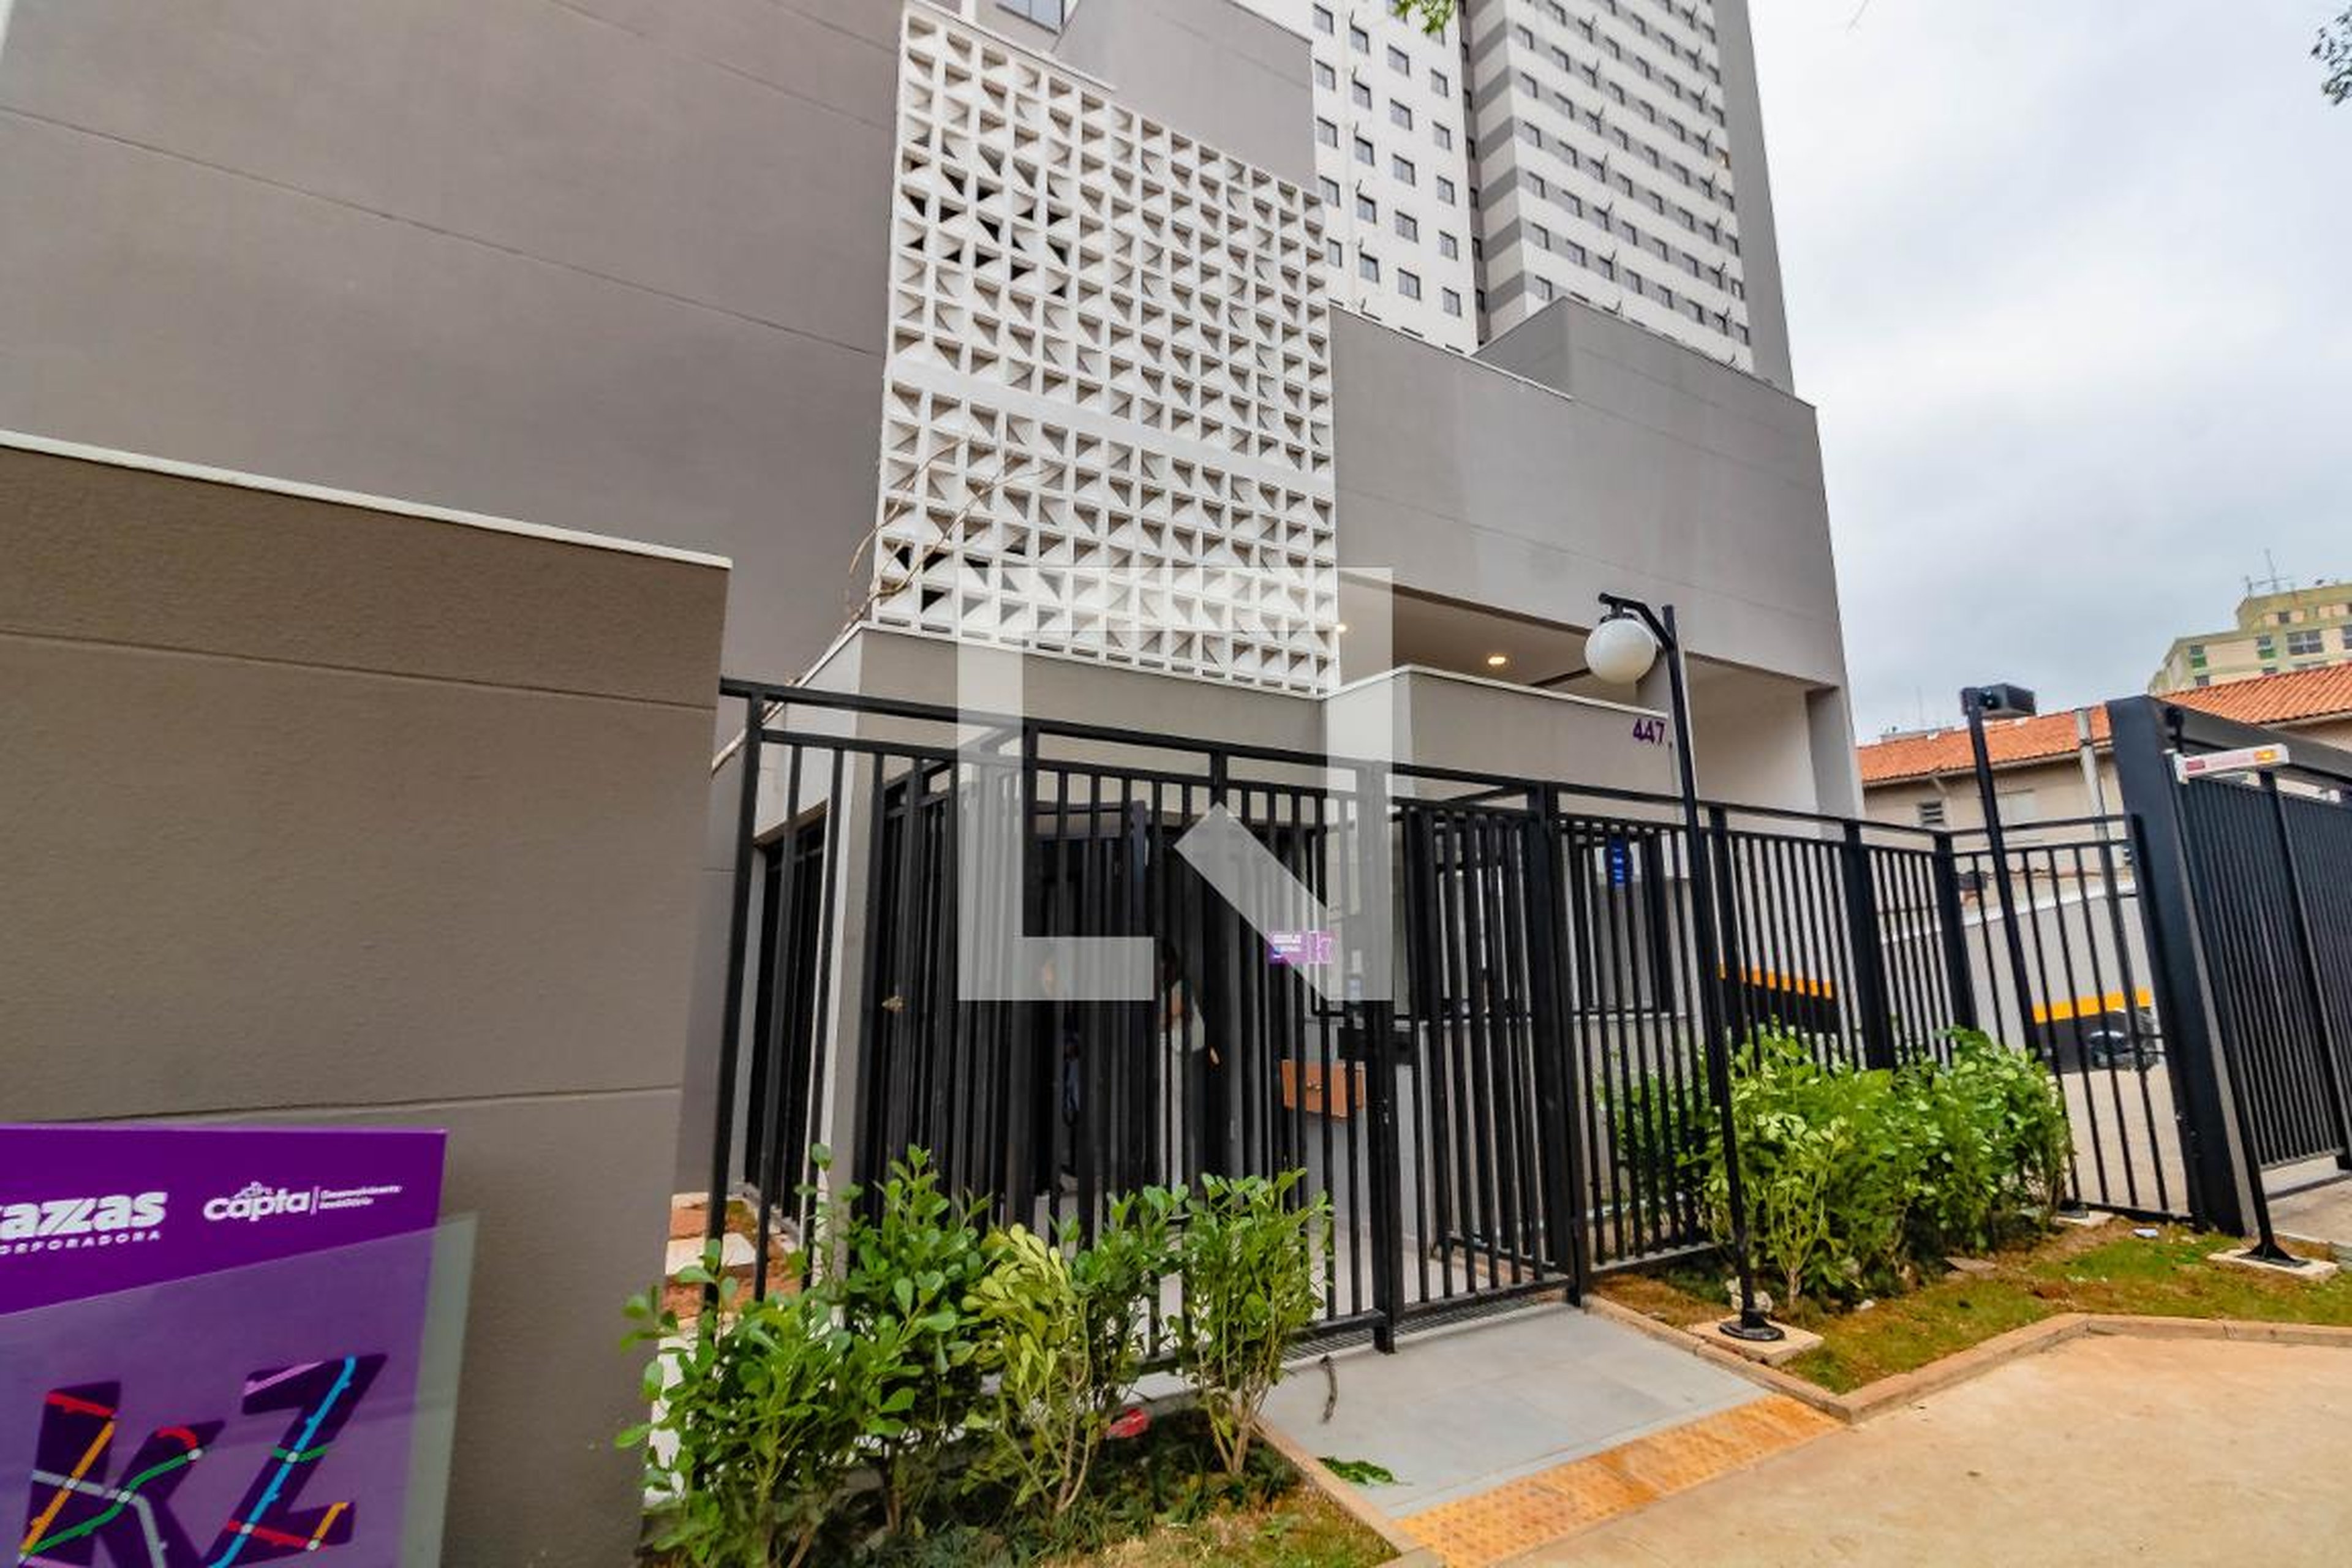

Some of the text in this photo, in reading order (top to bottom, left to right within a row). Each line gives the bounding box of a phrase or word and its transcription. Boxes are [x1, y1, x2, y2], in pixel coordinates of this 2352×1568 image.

[1633, 718, 1664, 744] 447
[0, 1191, 168, 1239] azzas
[203, 1187, 311, 1221] capta
